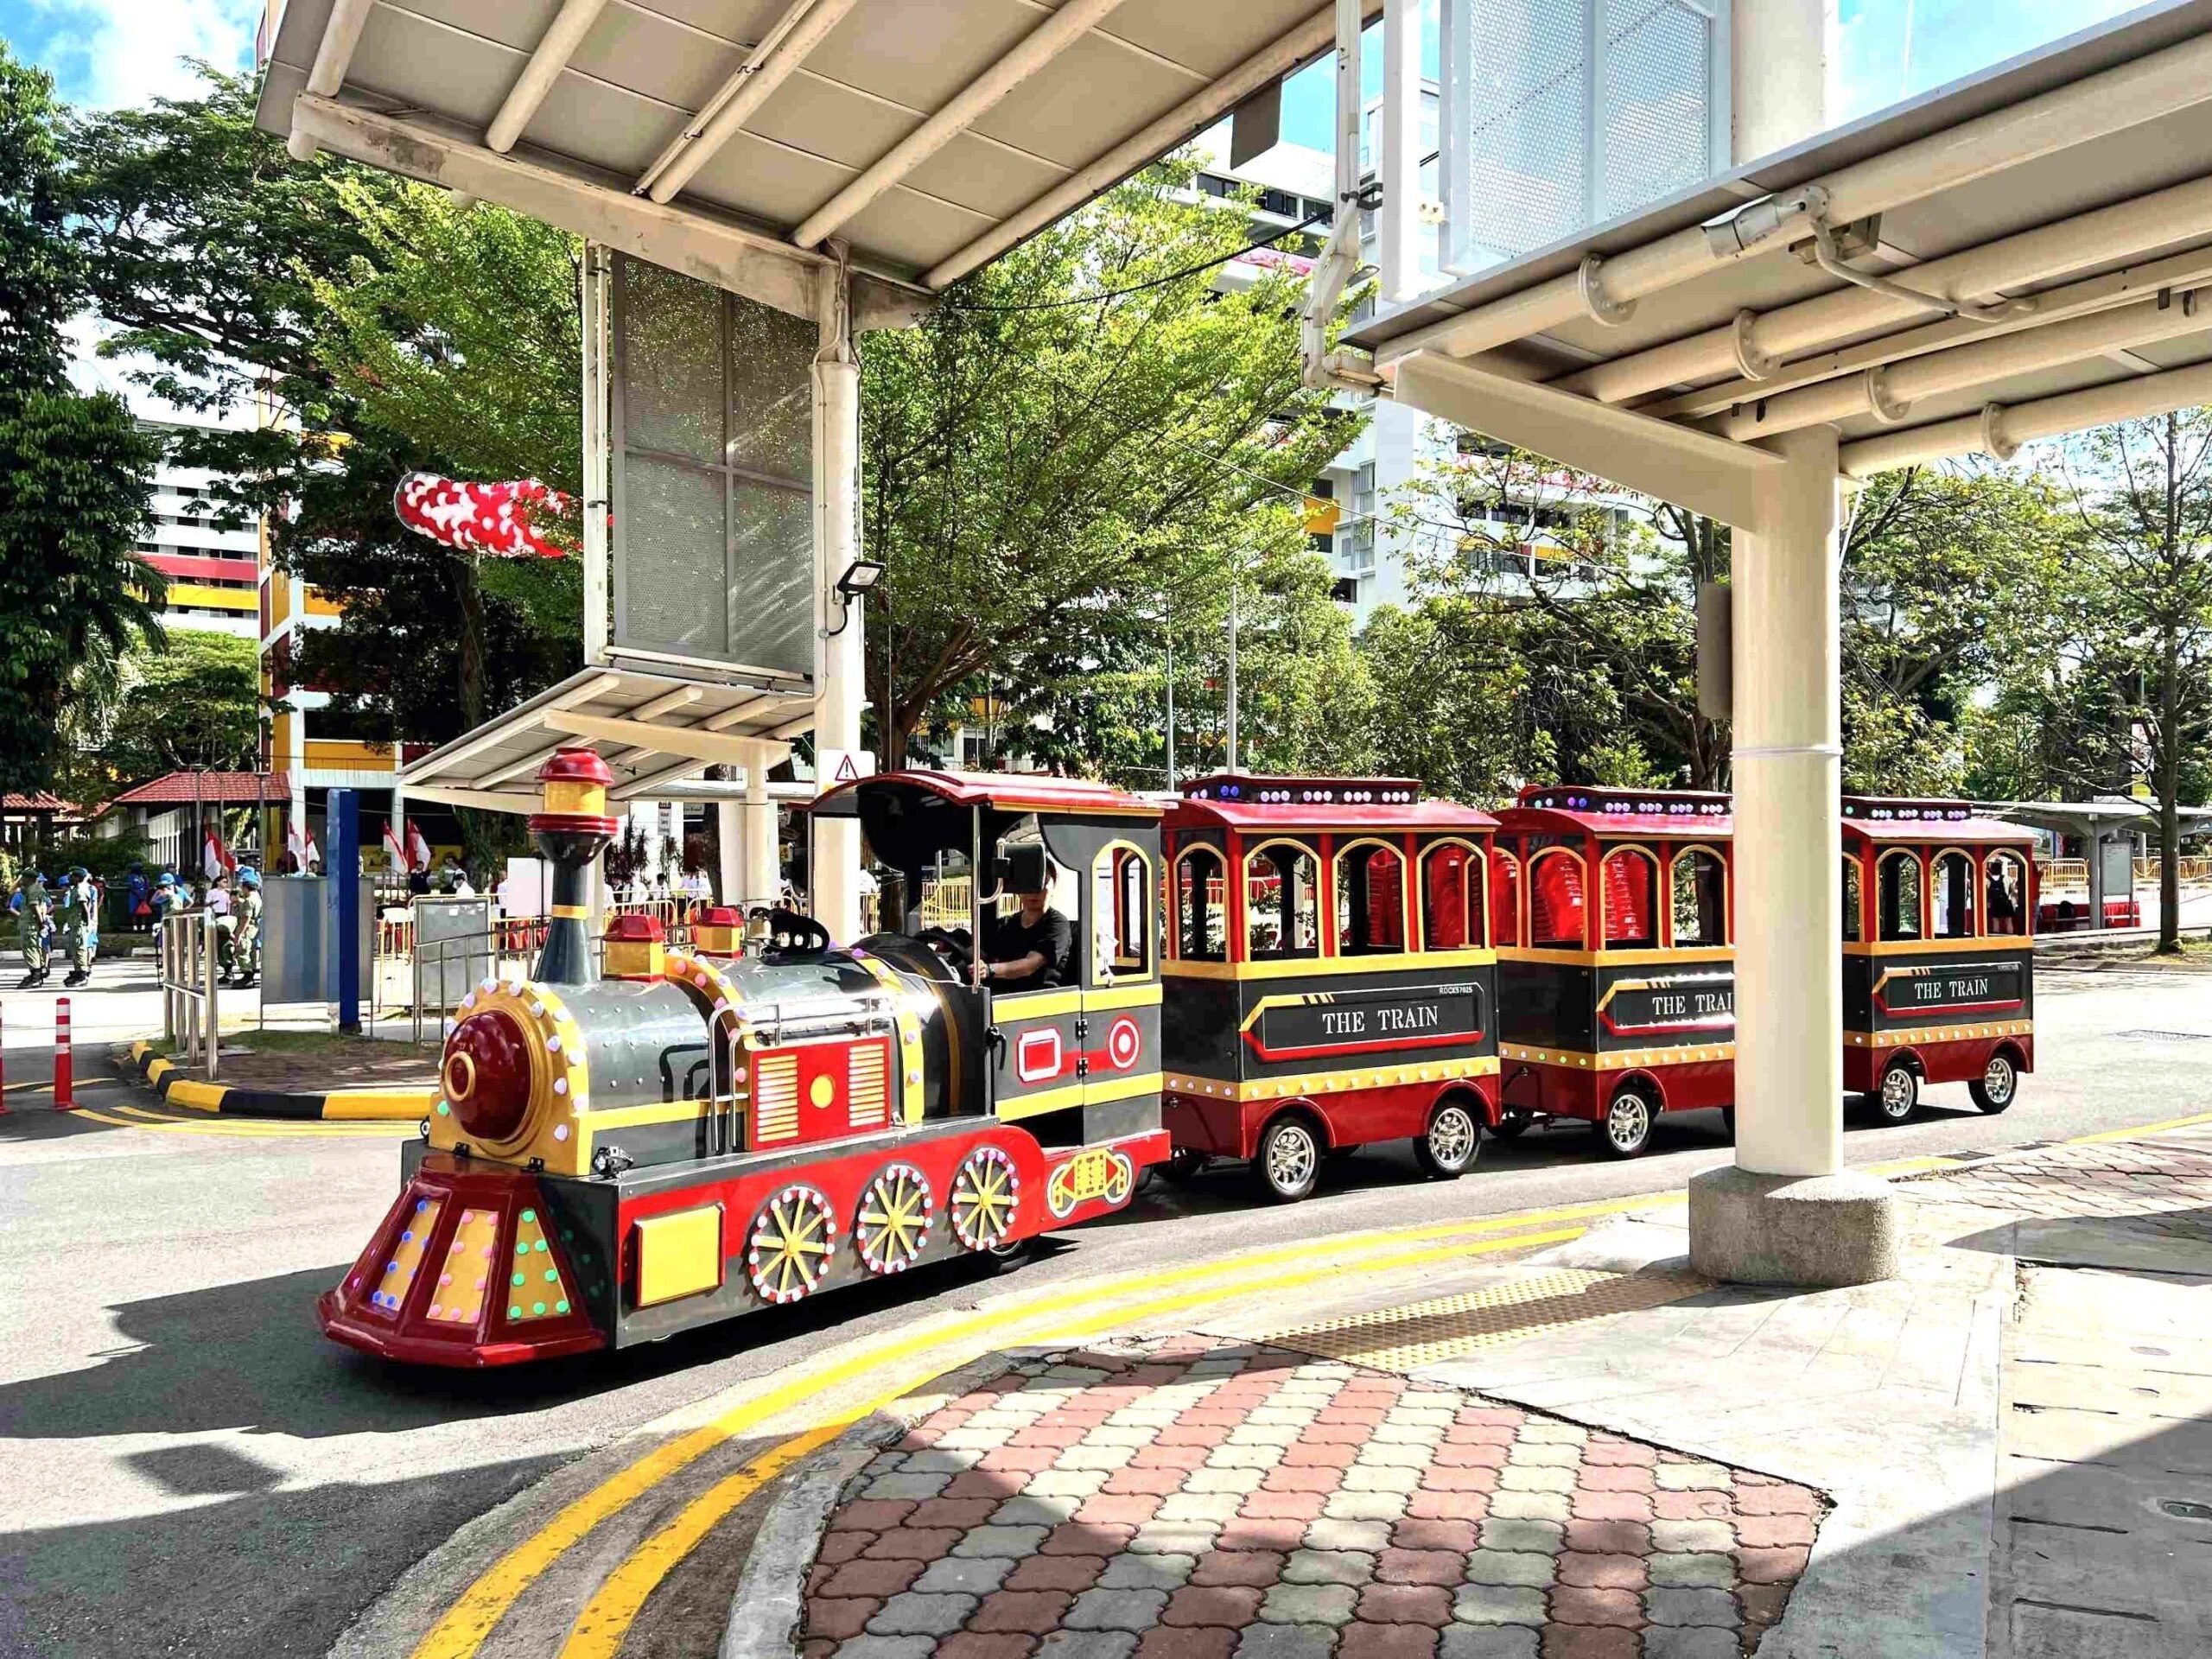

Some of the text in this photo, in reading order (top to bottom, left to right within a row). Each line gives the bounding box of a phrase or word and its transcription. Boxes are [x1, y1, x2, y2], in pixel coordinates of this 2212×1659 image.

[1914, 978, 1987, 1000] THE TRAIN
[1652, 993, 1732, 1015] THE TRAI
[1322, 1006, 1439, 1034] THE TRAIN
